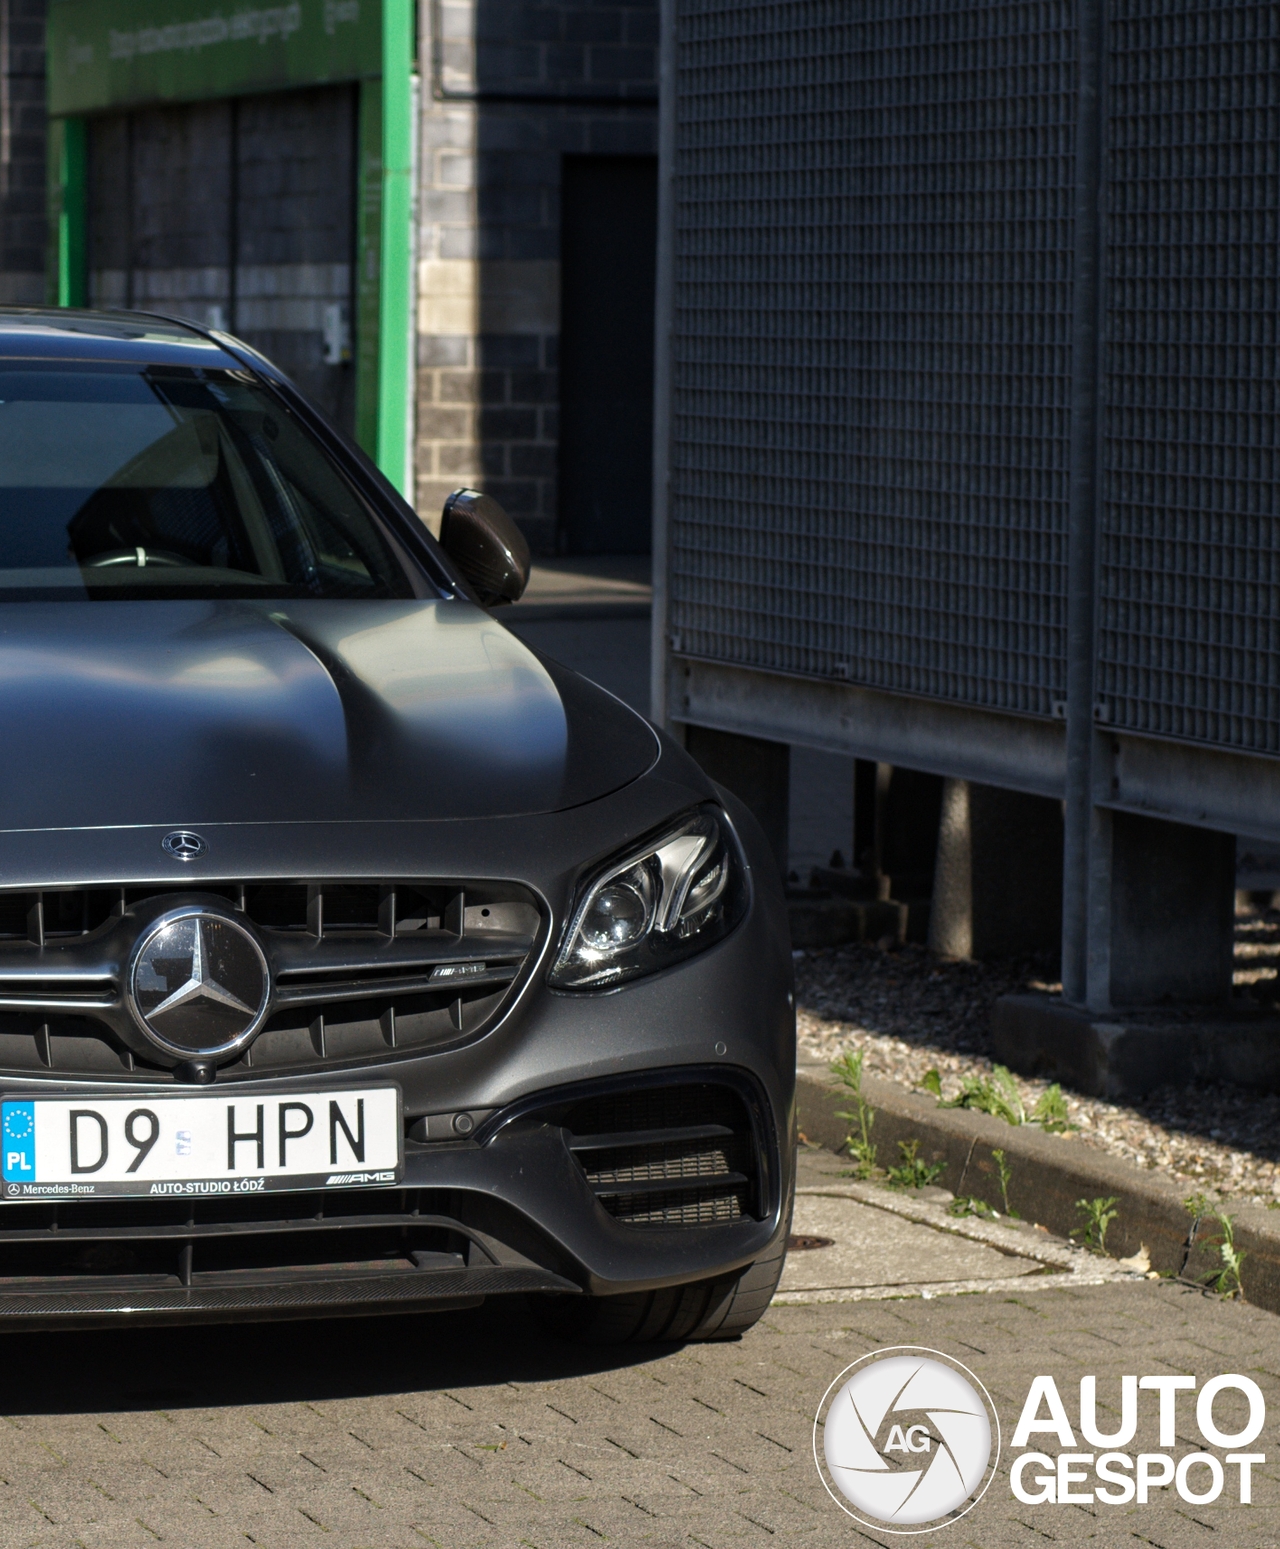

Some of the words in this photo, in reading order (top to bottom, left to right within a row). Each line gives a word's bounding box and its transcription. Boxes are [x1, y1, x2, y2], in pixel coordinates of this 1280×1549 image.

[69, 1108, 160, 1175] D9
[227, 1098, 365, 1170] HPN
[7, 1151, 32, 1171] PL
[150, 1181, 231, 1194] AUTO-STUDIO
[233, 1178, 265, 1192] ŁÓDŹ
[347, 1172, 396, 1184] AMG
[23, 1184, 95, 1195] Mercedes-Benz
